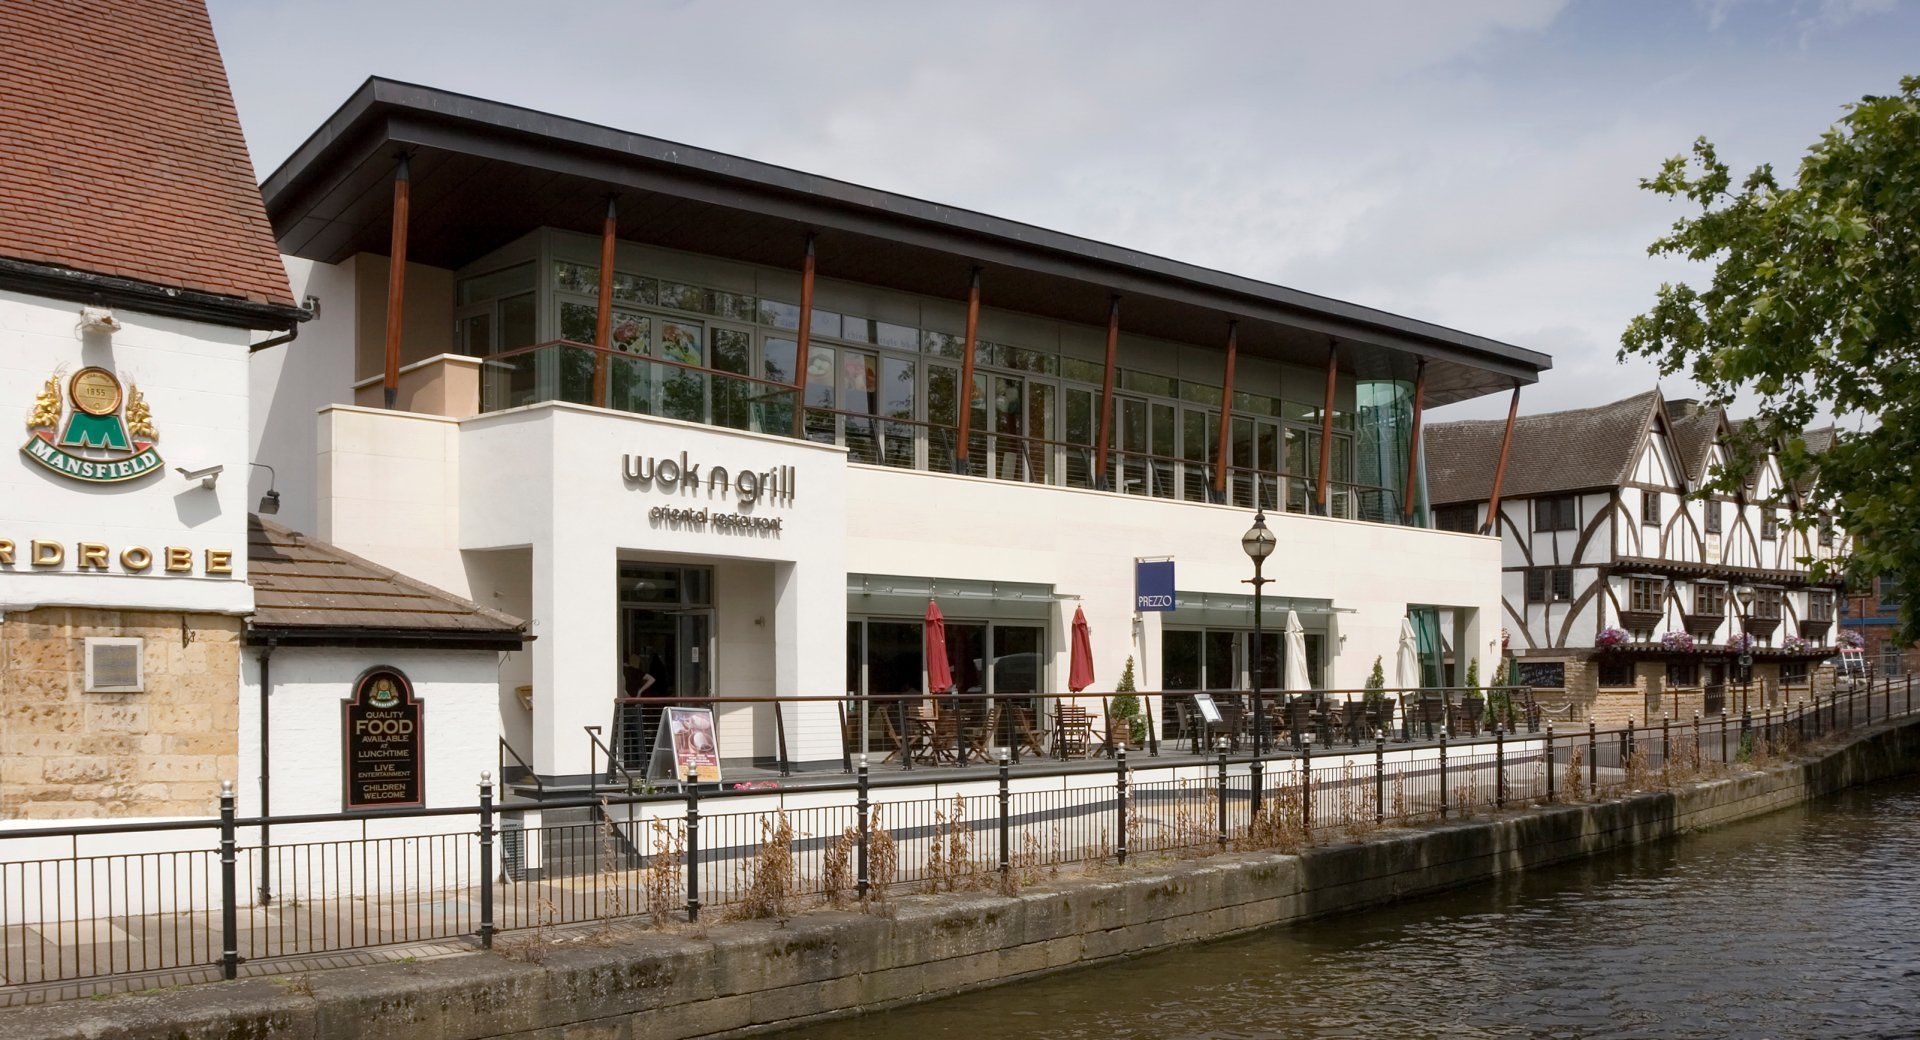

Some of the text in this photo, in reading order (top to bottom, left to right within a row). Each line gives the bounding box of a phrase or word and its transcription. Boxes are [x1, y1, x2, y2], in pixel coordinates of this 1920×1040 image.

[86, 387, 106, 397] 1855
[30, 439, 158, 478] MANSFIELD
[622, 450, 796, 505] wok n grill
[649, 503, 783, 532] oriental restaurant
[1138, 595, 1173, 607] PREZZO
[365, 711, 404, 719] QUALITY
[355, 719, 413, 735] FOOD
[362, 735, 409, 743] AVAILABLE
[358, 749, 409, 758] LUNCHTIME
[374, 764, 395, 772] LIVE
[363, 783, 406, 792] CHILDREN
[363, 791, 406, 799] WELCOME
